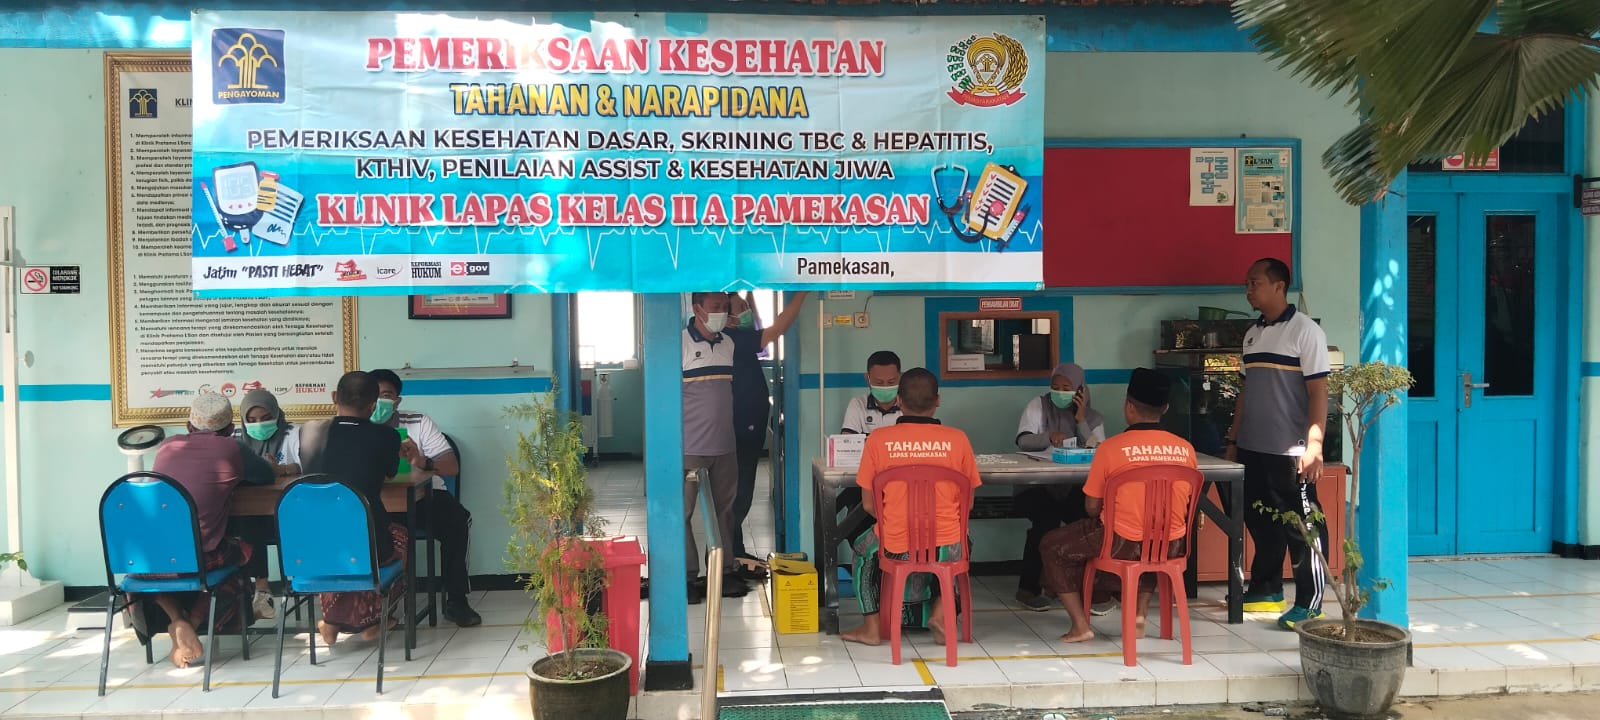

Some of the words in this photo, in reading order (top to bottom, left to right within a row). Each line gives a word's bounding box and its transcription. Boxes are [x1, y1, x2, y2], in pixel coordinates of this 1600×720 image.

[367, 37, 648, 71] PEMERIKSAAN
[658, 39, 885, 73] KESEHATAN
[218, 90, 280, 99] PENGAYOMAN
[450, 84, 590, 116] TAHANAN
[597, 84, 617, 116] &
[622, 85, 809, 118] NARAPIDANA
[248, 130, 425, 149] PEMERIKSAAN
[434, 130, 579, 149] KESEHATAN
[588, 131, 674, 152] DASAR,
[681, 132, 793, 150] SKRINING
[800, 132, 845, 150] TBC
[852, 132, 867, 150] &
[874, 132, 993, 153] HEPATITIS,
[357, 158, 435, 182] KTHIV,
[442, 159, 574, 178] PENILAIAN
[581, 160, 660, 178] ASSIST
[667, 160, 683, 179] &
[690, 160, 829, 179] KESEHATAN
[834, 161, 894, 179] JIWA
[317, 195, 433, 225] KLINIK
[441, 194, 551, 226] LAPAS
[559, 195, 663, 225] KELAS
[672, 195, 697, 225] II
[703, 195, 728, 225] A
[734, 195, 929, 226] PAMEKASAN
[203, 266, 238, 280] Jatim
[376, 266, 396, 275] icare
[411, 267, 442, 279] HUKUM
[797, 257, 895, 278] Pamekasan,
[885, 441, 952, 452] TAHANAN
[1122, 445, 1189, 457] TAHANAN
[1150, 455, 1187, 463] PAMEKASAN
